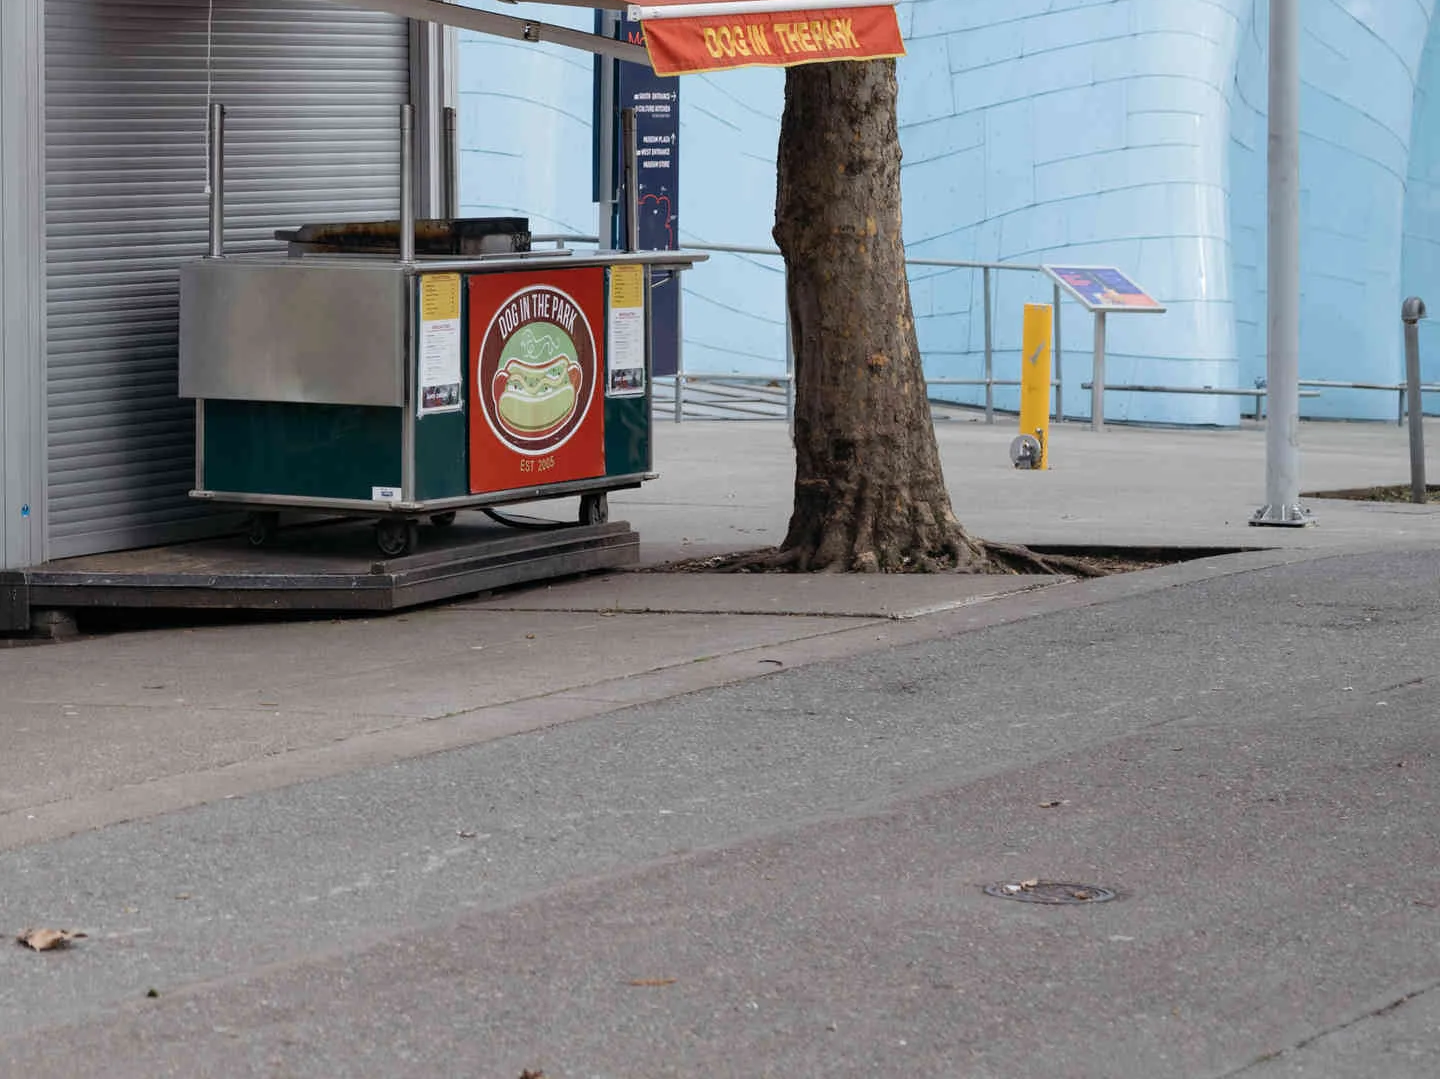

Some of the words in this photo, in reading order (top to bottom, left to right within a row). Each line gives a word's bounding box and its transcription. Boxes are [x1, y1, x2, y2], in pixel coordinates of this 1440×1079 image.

[704, 25, 751, 58] DOG
[747, 23, 772, 56] IN
[773, 21, 817, 54] THE
[810, 18, 860, 51] PARK
[499, 303, 519, 339] DOG
[520, 295, 531, 322] IN
[532, 293, 550, 318] THE
[552, 296, 577, 335] PARK
[521, 459, 535, 472] EST
